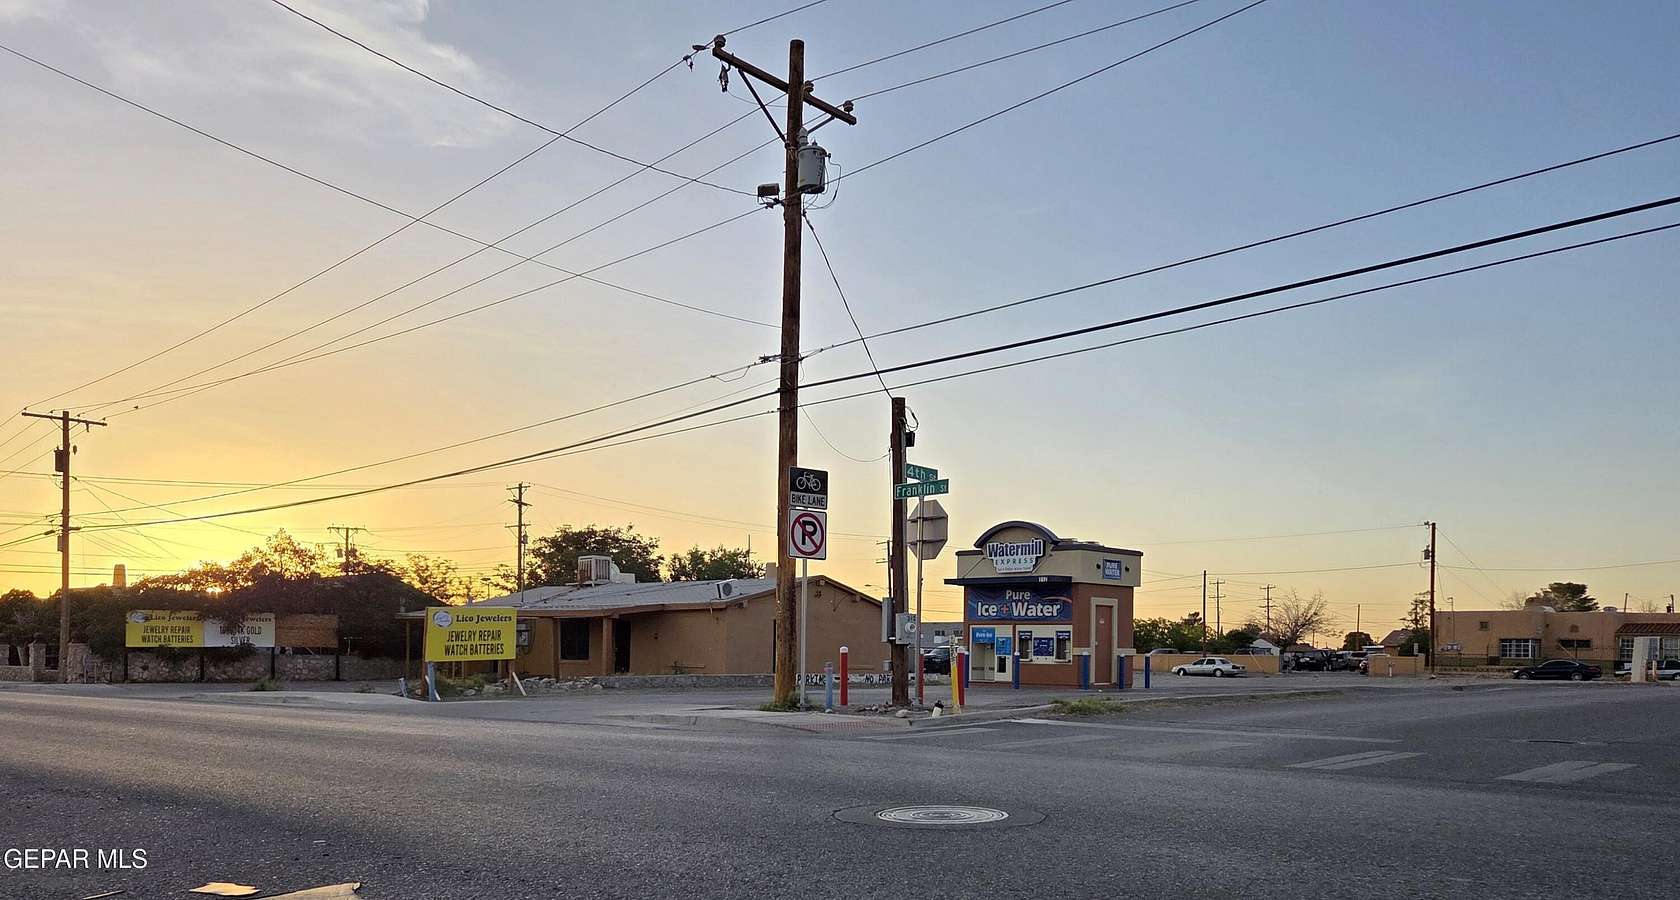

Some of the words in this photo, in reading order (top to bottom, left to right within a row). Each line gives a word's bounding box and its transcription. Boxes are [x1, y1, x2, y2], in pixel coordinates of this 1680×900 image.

[906, 466, 926, 477] 4th
[896, 485, 935, 497] Franklin
[791, 495, 806, 504] BIKE
[808, 496, 825, 506] LANE
[801, 520, 817, 545] P
[987, 539, 1043, 558] Watermill
[995, 557, 1034, 566] EXPRESS
[1104, 568, 1121, 577] WATER
[1006, 589, 1031, 600] Pure
[977, 602, 998, 617] Ice
[1012, 602, 1062, 617] Water
[455, 614, 474, 623] Lico
[475, 614, 512, 624] Jewelers
[143, 625, 168, 634] JEWELRY
[170, 625, 191, 634] REPAIR
[246, 625, 262, 635] GOLD
[141, 634, 162, 644] WATCH
[163, 634, 194, 644] BATTERIES
[447, 630, 476, 642] JEWELRY
[478, 629, 502, 641] REPAIR
[444, 643, 468, 656] WATCH
[469, 643, 504, 655] BATTERIES
[865, 675, 874, 684] NO
